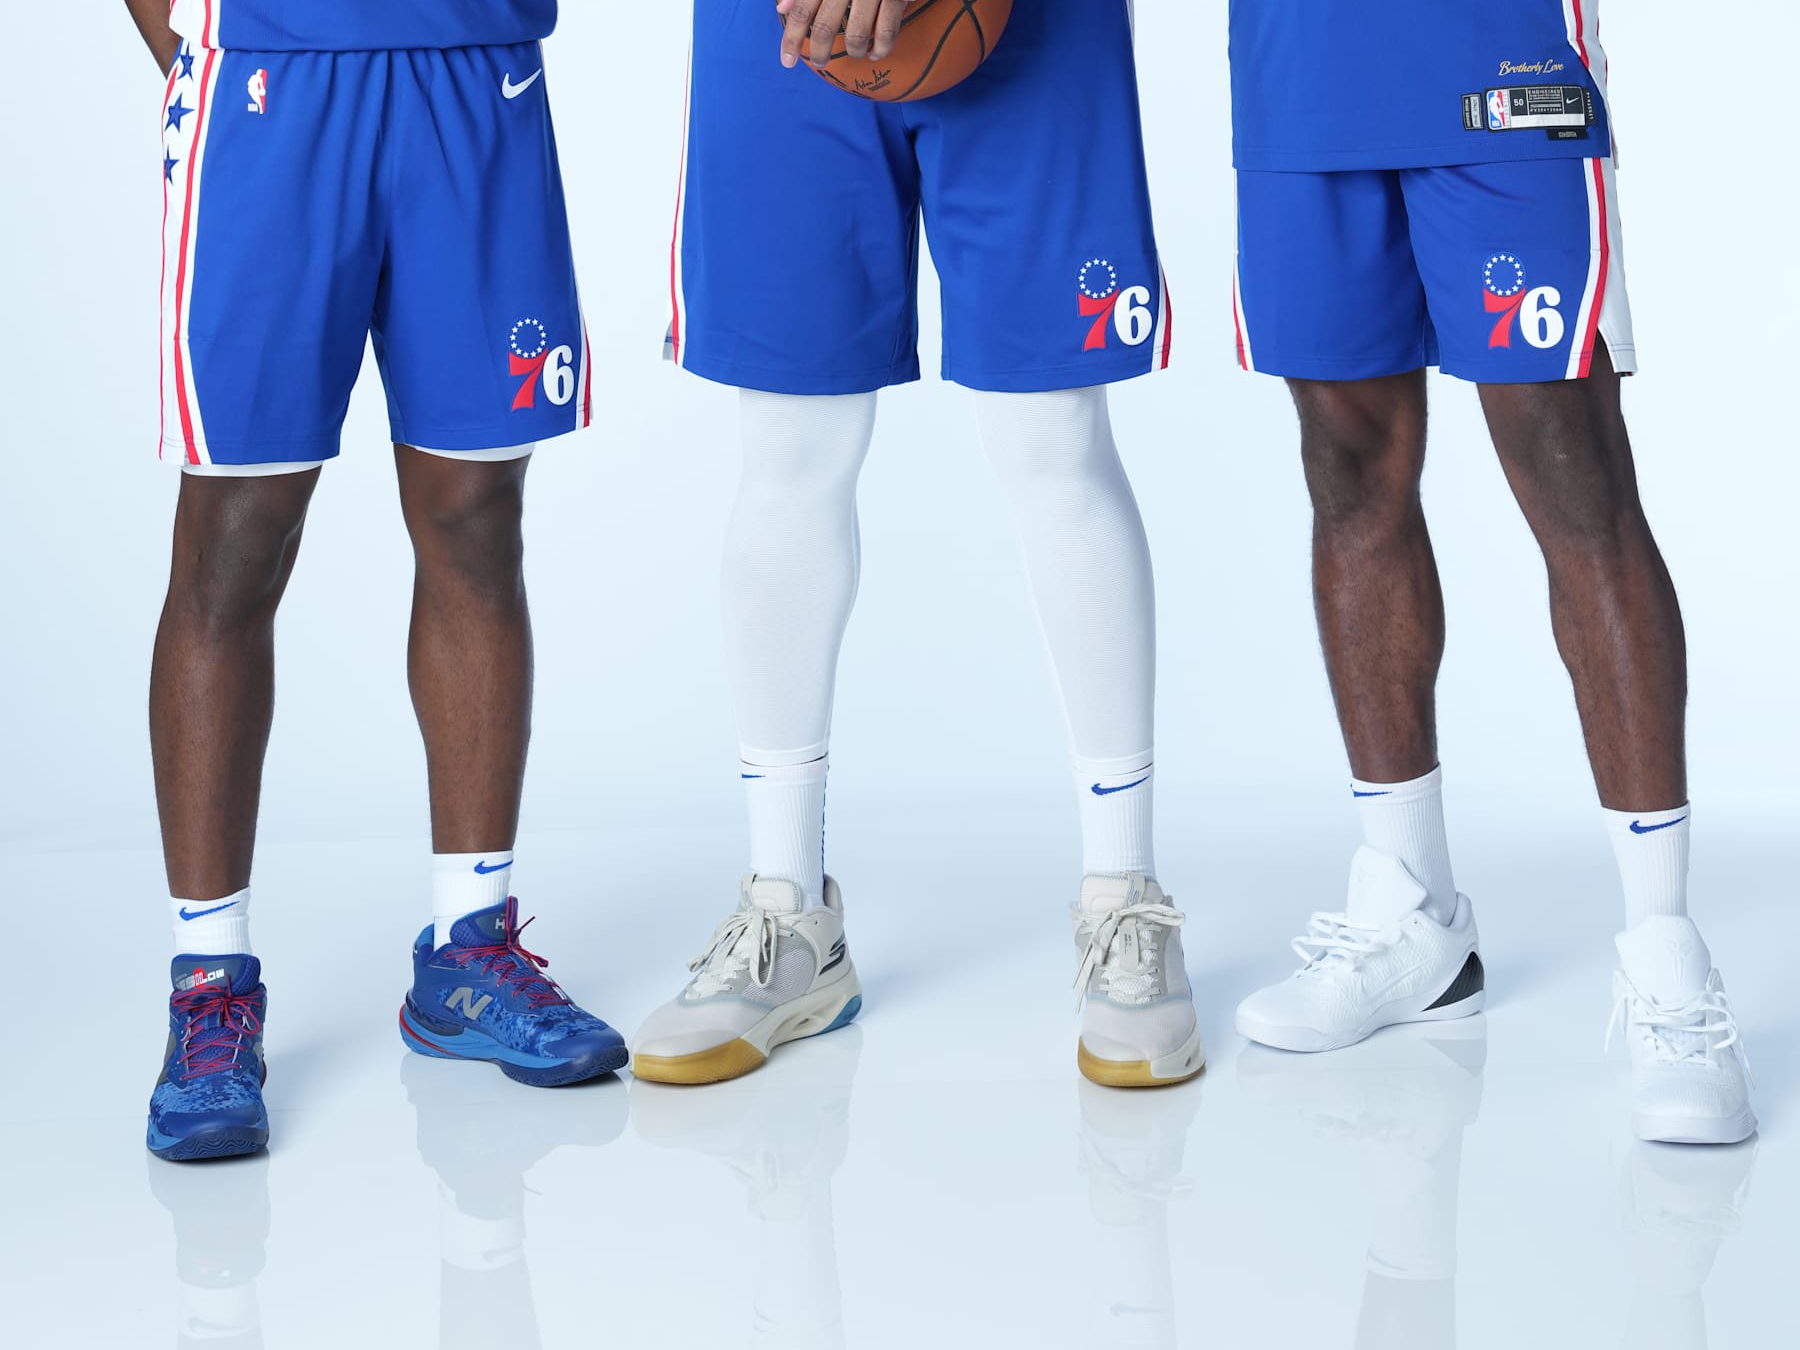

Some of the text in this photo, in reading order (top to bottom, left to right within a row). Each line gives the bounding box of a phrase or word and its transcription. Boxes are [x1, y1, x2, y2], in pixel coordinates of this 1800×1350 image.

[1498, 58, 1564, 76] Brotherly Love
[1513, 98, 1524, 107] 50
[1078, 285, 1153, 352] 76
[1483, 285, 1565, 349] 76
[508, 344, 575, 411] 76
